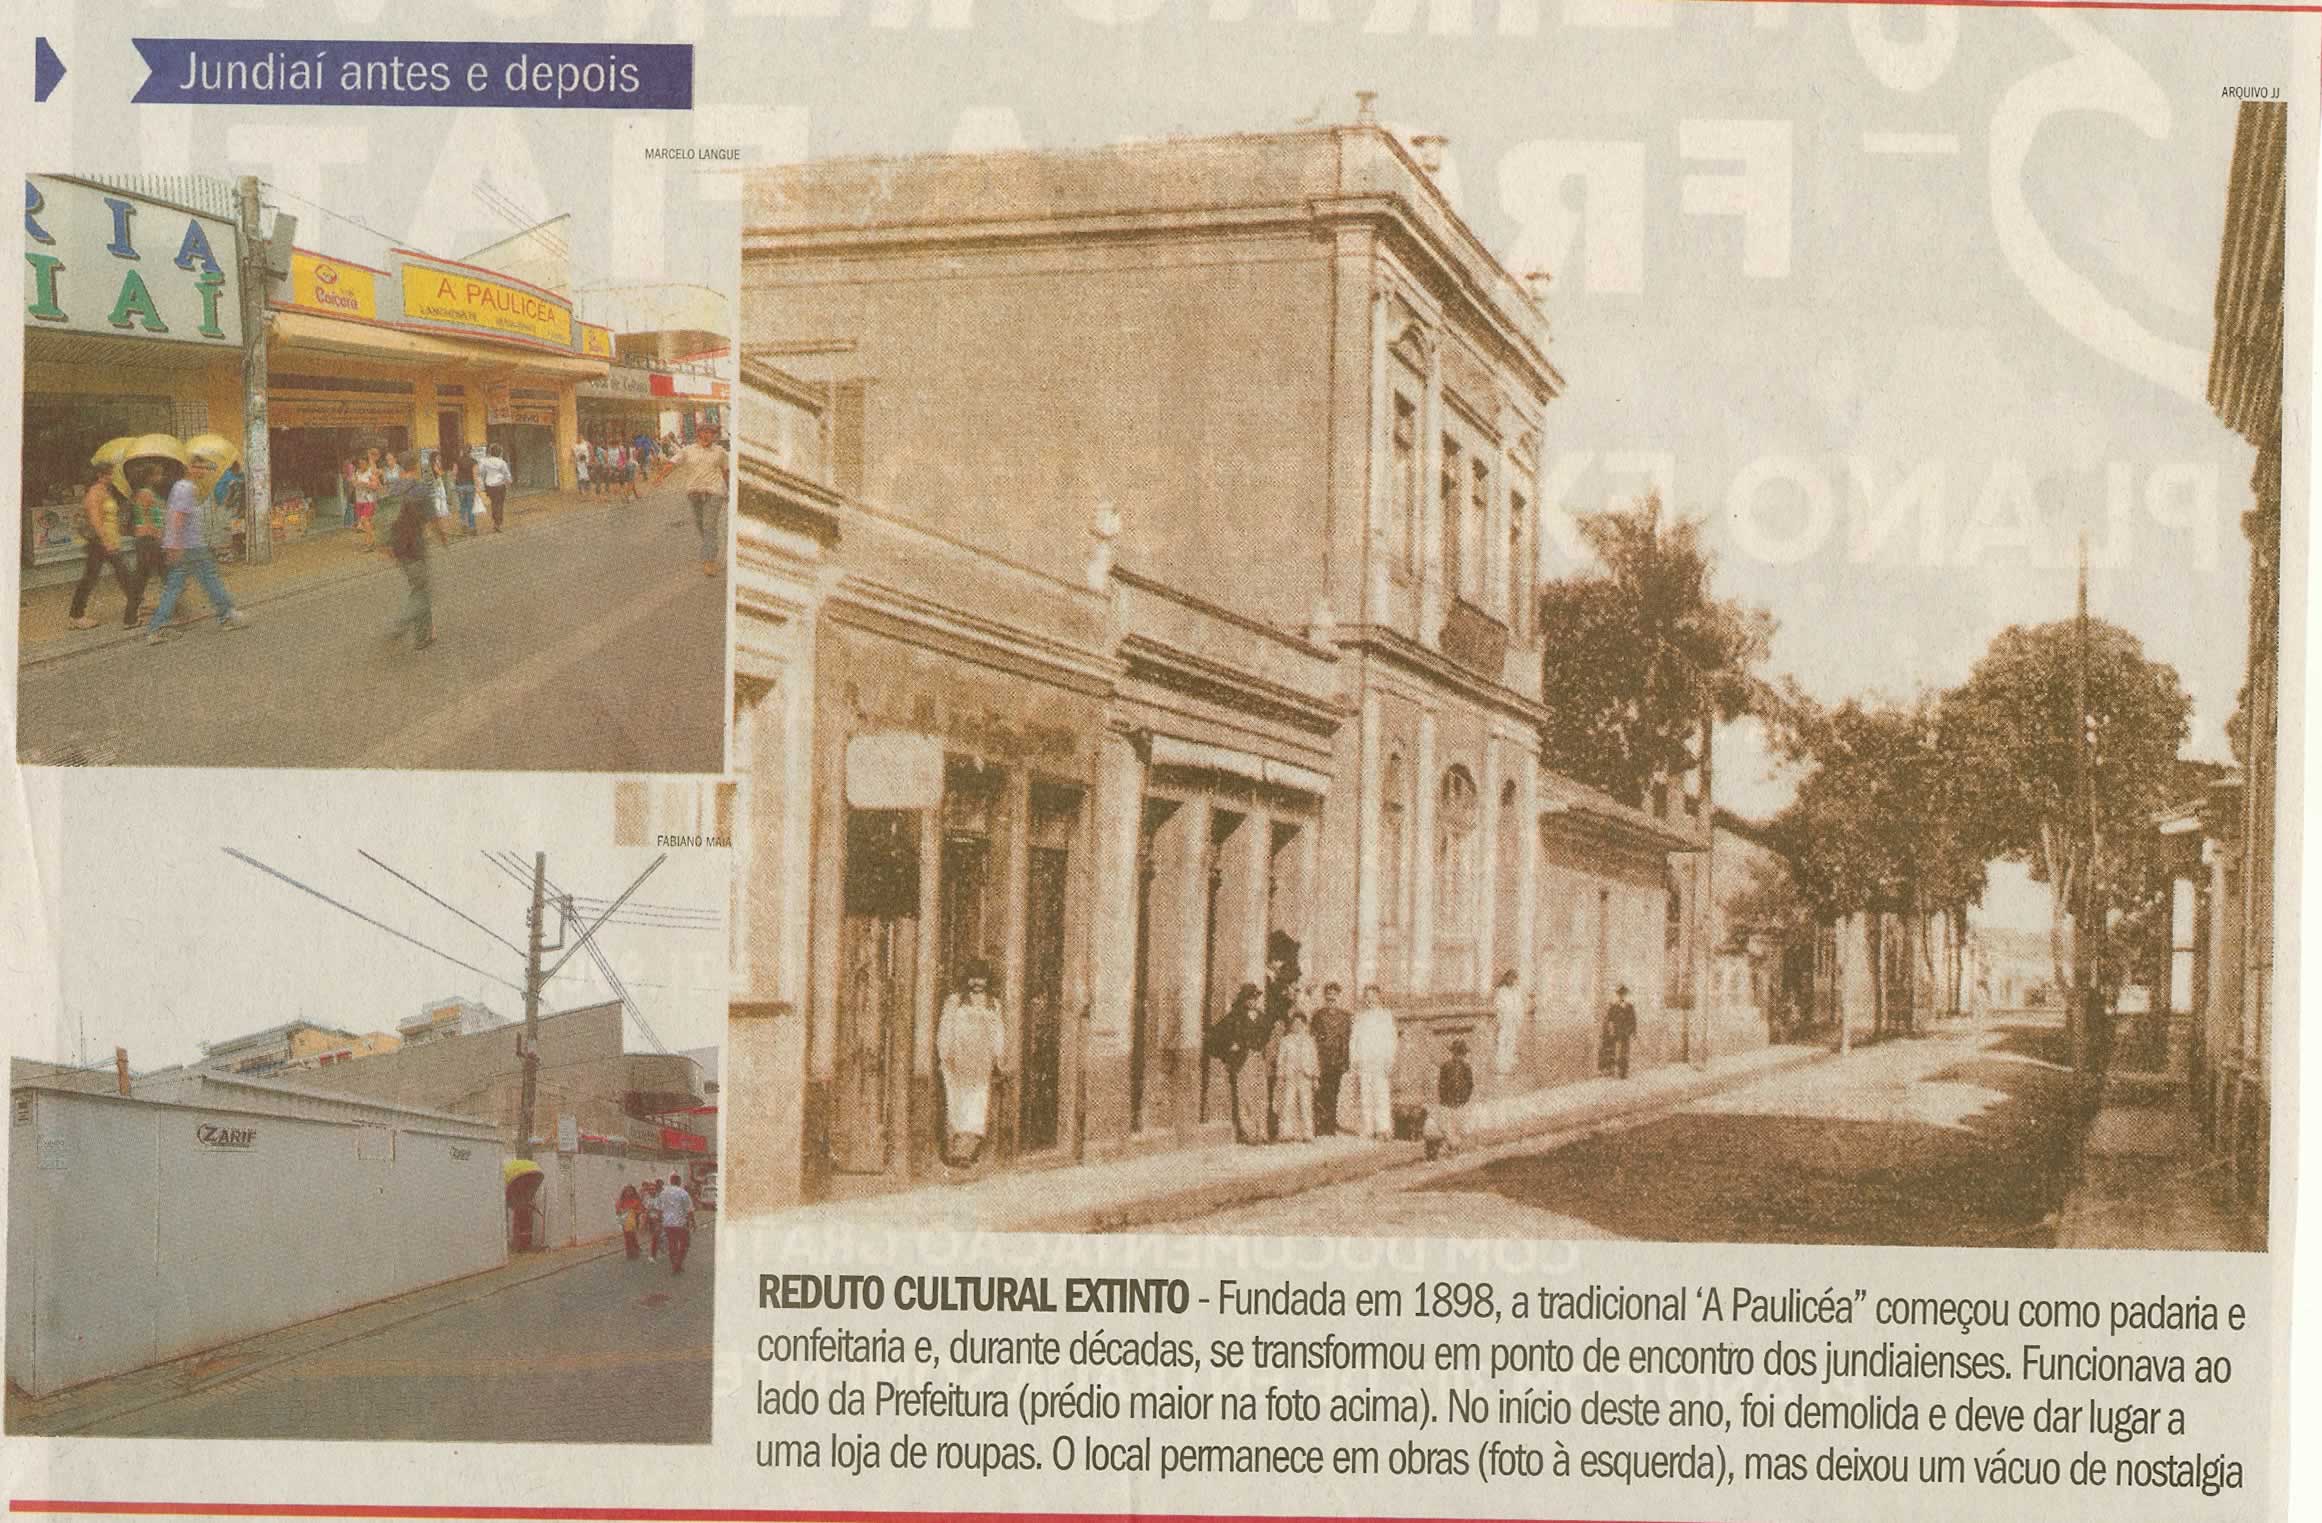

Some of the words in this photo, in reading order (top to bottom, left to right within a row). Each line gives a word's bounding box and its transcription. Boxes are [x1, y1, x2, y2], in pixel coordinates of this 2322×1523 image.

[179, 50, 327, 91] Jundiaí
[340, 56, 451, 92] antes
[466, 63, 488, 92] e
[505, 54, 640, 100] depois
[2221, 86, 2268, 100] ARQUIVO
[2270, 87, 2280, 98] JJ
[644, 148, 696, 160] MARCELO
[698, 148, 741, 160] LANGUE
[437, 277, 457, 301] A
[657, 834, 702, 847] FABIANO
[706, 836, 732, 847] MAIA
[759, 1273, 885, 1310] REDUTO
[893, 1275, 1058, 1313] CULTURAL
[1065, 1277, 1190, 1315] EXTINTO
[1219, 1279, 1346, 1317] Fundada
[1355, 1289, 1402, 1317] em
[1415, 1281, 1502, 1324] 1898,
[1511, 1291, 1529, 1319] a
[1537, 1284, 1687, 1322] tradicional
[1875, 1297, 2009, 1336] começou
[2018, 1300, 2101, 1329] como
[2110, 1294, 2218, 1337] padaria
[2228, 1303, 2246, 1331] e
[757, 1326, 905, 1364] confeitaria
[914, 1336, 940, 1369] e,
[949, 1328, 1061, 1365] durante
[1069, 1328, 1201, 1374] décadas,
[1209, 1339, 1245, 1368] se
[1251, 1333, 1425, 1371] transformou
[1434, 1343, 1480, 1371] em
[1491, 1339, 1574, 1380] ponto
[1582, 1337, 1620, 1374] de
[1628, 1342, 1754, 1376] encontro
[1763, 1339, 1818, 1377] dos
[1821, 1340, 2012, 1385] jundiaienses.
[2023, 1344, 2185, 1383] Funcionava
[2194, 1356, 2232, 1384] ao
[757, 1379, 819, 1416] lado
[828, 1380, 865, 1416] da
[876, 1381, 1009, 1418] Prefeitura
[1019, 1381, 1121, 1426] (prédio
[1130, 1384, 1214, 1420] maior
[1221, 1393, 1257, 1421] na
[1264, 1385, 1321, 1422] foto
[1329, 1387, 1438, 1431] acima).
[1448, 1388, 1489, 1424] No
[1499, 1387, 1572, 1425] início
[1580, 1390, 1660, 1427] deste
[1668, 1399, 1731, 1433] ano,
[1740, 1392, 1775, 1428] foi
[1784, 1393, 1919, 1431] demolida
[1928, 1404, 1947, 1432] e
[1955, 1396, 2025, 1433] deve
[2033, 1398, 2083, 1434] dar
[2089, 1398, 2162, 1443] lugar
[2167, 1408, 2185, 1436] a
[756, 1440, 821, 1468] uma
[831, 1432, 880, 1476] loja
[890, 1433, 928, 1469] de
[936, 1442, 1042, 1478] roupas.
[1052, 1435, 1075, 1471] O
[1085, 1435, 1151, 1472] local
[1161, 1445, 1324, 1480] permanece
[1332, 1447, 1379, 1474] em
[1388, 1439, 1470, 1476] obras
[1478, 1440, 1544, 1484] (foto
[1552, 1439, 1570, 1477] à
[1580, 1444, 1734, 1487] esquerda),
[1745, 1453, 1808, 1481] mas
[1815, 1446, 1909, 1483] deixou
[1919, 1456, 1965, 1484] um
[1973, 1447, 2061, 1485] vácuo
[2069, 1450, 2107, 1486] de
[2116, 1452, 2243, 1497] nostalgia
